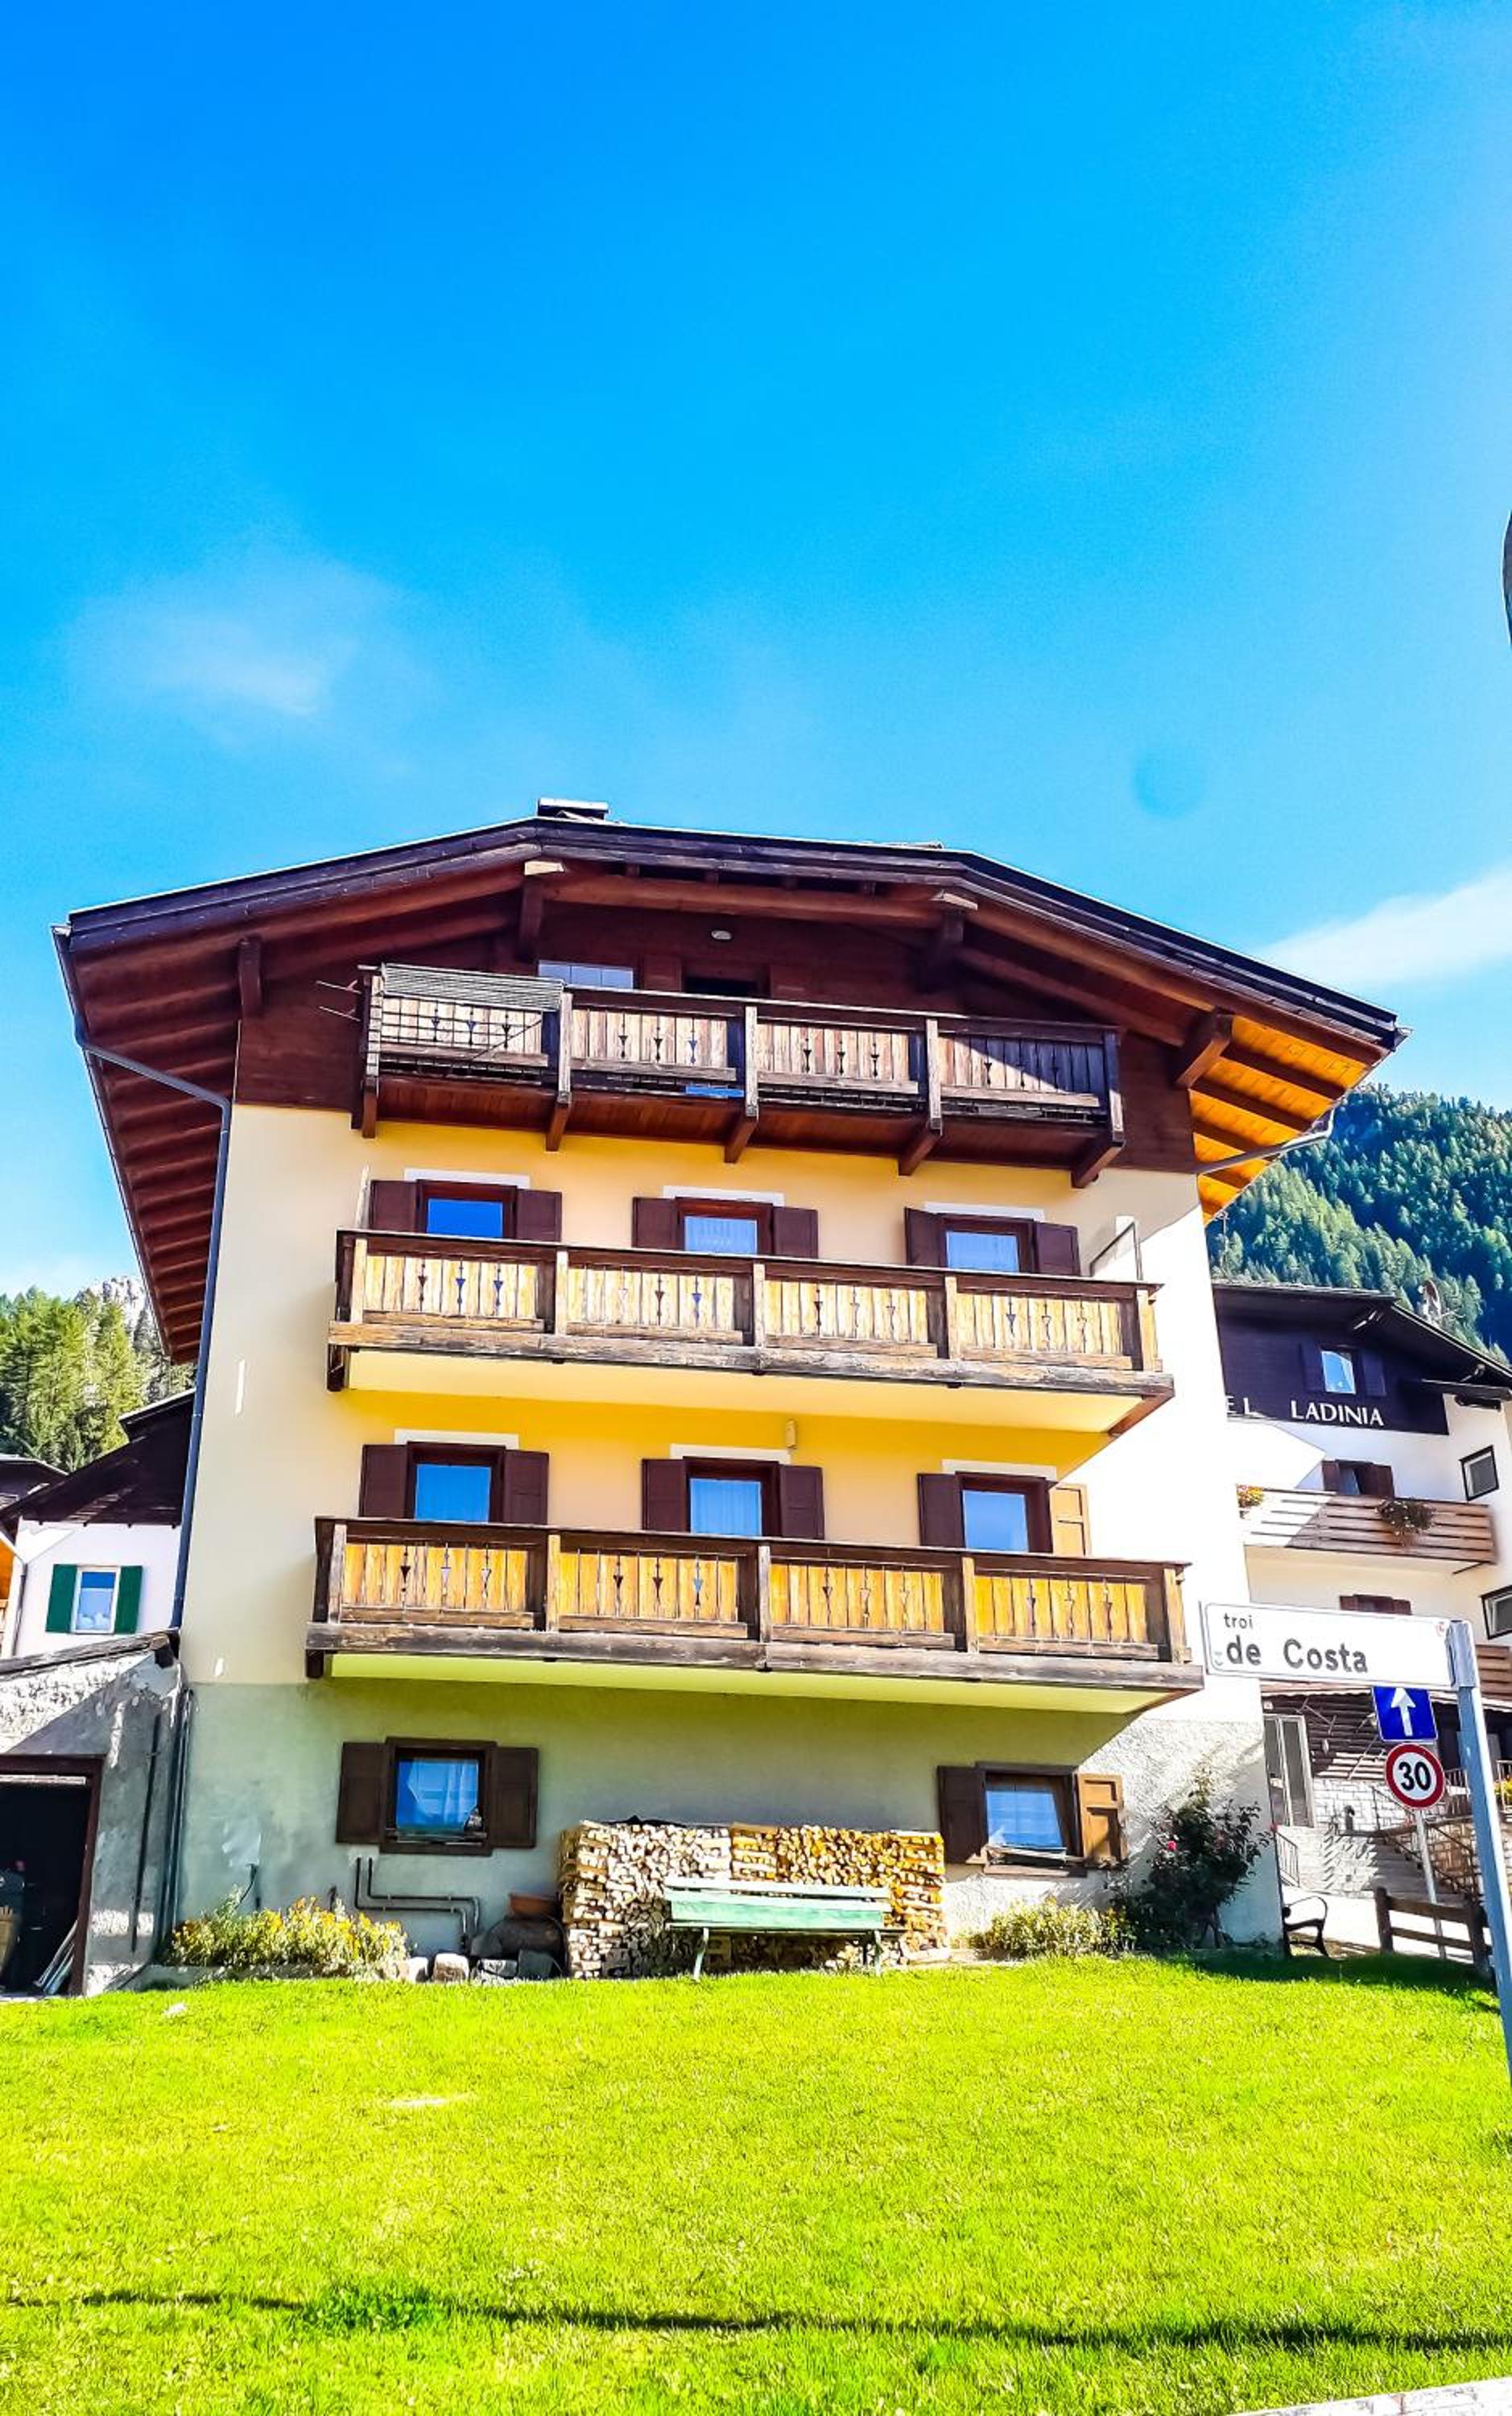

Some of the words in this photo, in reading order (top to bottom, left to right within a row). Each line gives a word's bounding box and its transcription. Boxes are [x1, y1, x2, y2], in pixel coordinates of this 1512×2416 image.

[1291, 1400, 1384, 1426] LADINIA
[1223, 1613, 1254, 1629] troi
[1226, 1635, 1261, 1665] de
[1283, 1638, 1368, 1673] Costa
[1398, 1761, 1431, 1791] 30
